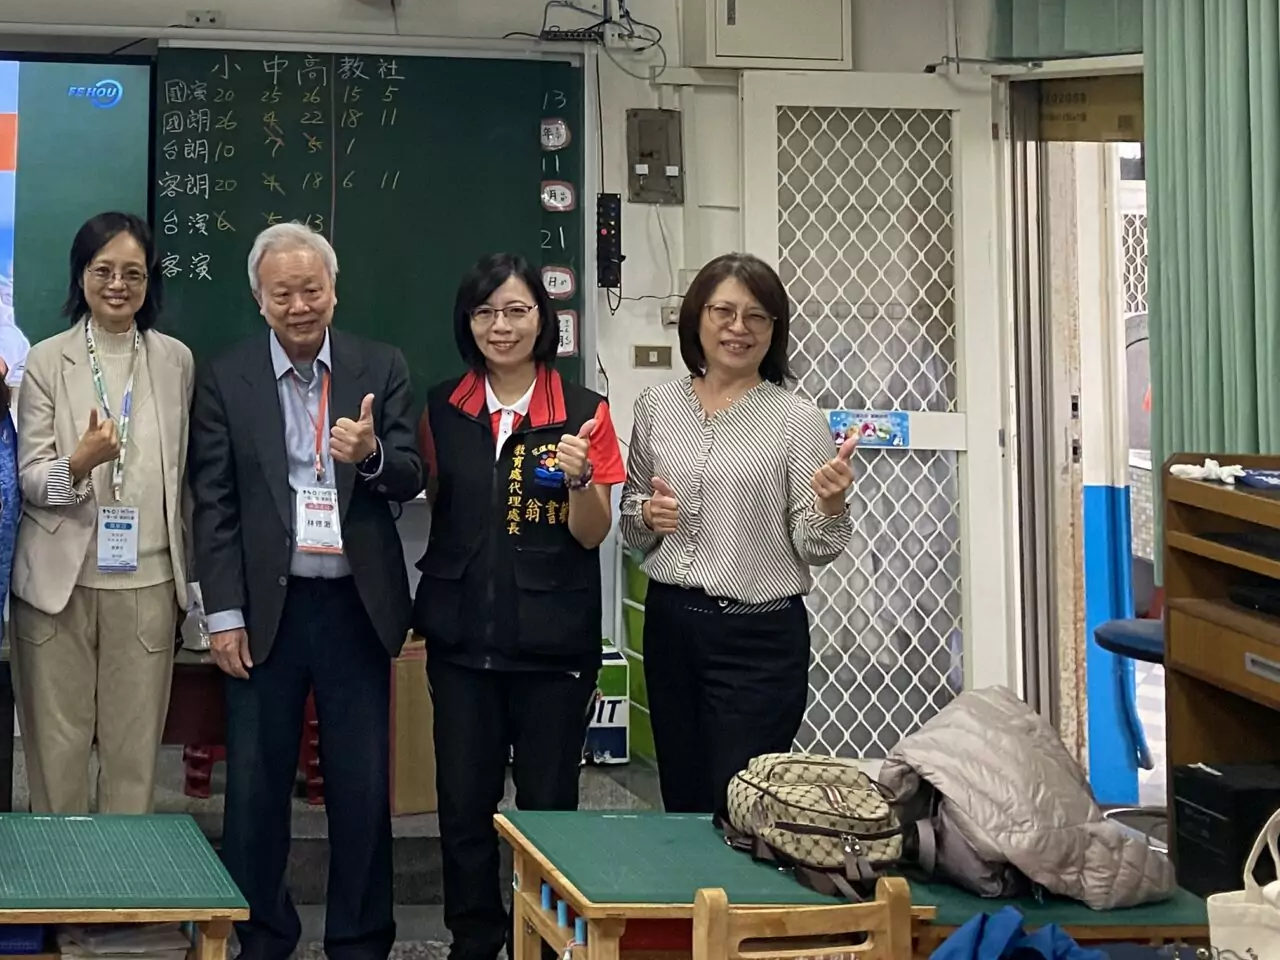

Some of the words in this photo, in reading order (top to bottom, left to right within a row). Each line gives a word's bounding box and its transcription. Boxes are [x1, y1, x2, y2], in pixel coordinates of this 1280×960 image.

[211, 54, 242, 80] 小
[263, 55, 289, 84] 中
[297, 55, 327, 86] 高
[337, 56, 370, 80] 教
[378, 58, 406, 81] 社
[213, 88, 235, 102] 20
[261, 88, 283, 103] 25
[302, 90, 321, 103] 26
[343, 88, 362, 103] 15
[382, 87, 399, 102] 5
[542, 89, 567, 110] 13
[163, 109, 210, 135] 國朗
[214, 110, 238, 130] 26
[300, 111, 325, 125] 22
[340, 108, 363, 128] 18
[381, 107, 397, 127] 11
[162, 138, 209, 164] 台朗
[214, 141, 235, 162] 10
[346, 138, 356, 156] 1
[541, 154, 560, 173] 11
[158, 171, 210, 200] 客朗
[214, 178, 237, 192] 20
[302, 172, 324, 190] 18
[342, 170, 356, 189] 6
[380, 171, 401, 190] 11
[162, 209, 210, 237] 台演
[305, 213, 324, 233] 13
[540, 226, 565, 249] 21
[161, 251, 213, 281] 客演
[506, 444, 526, 535] 教育處代理處長
